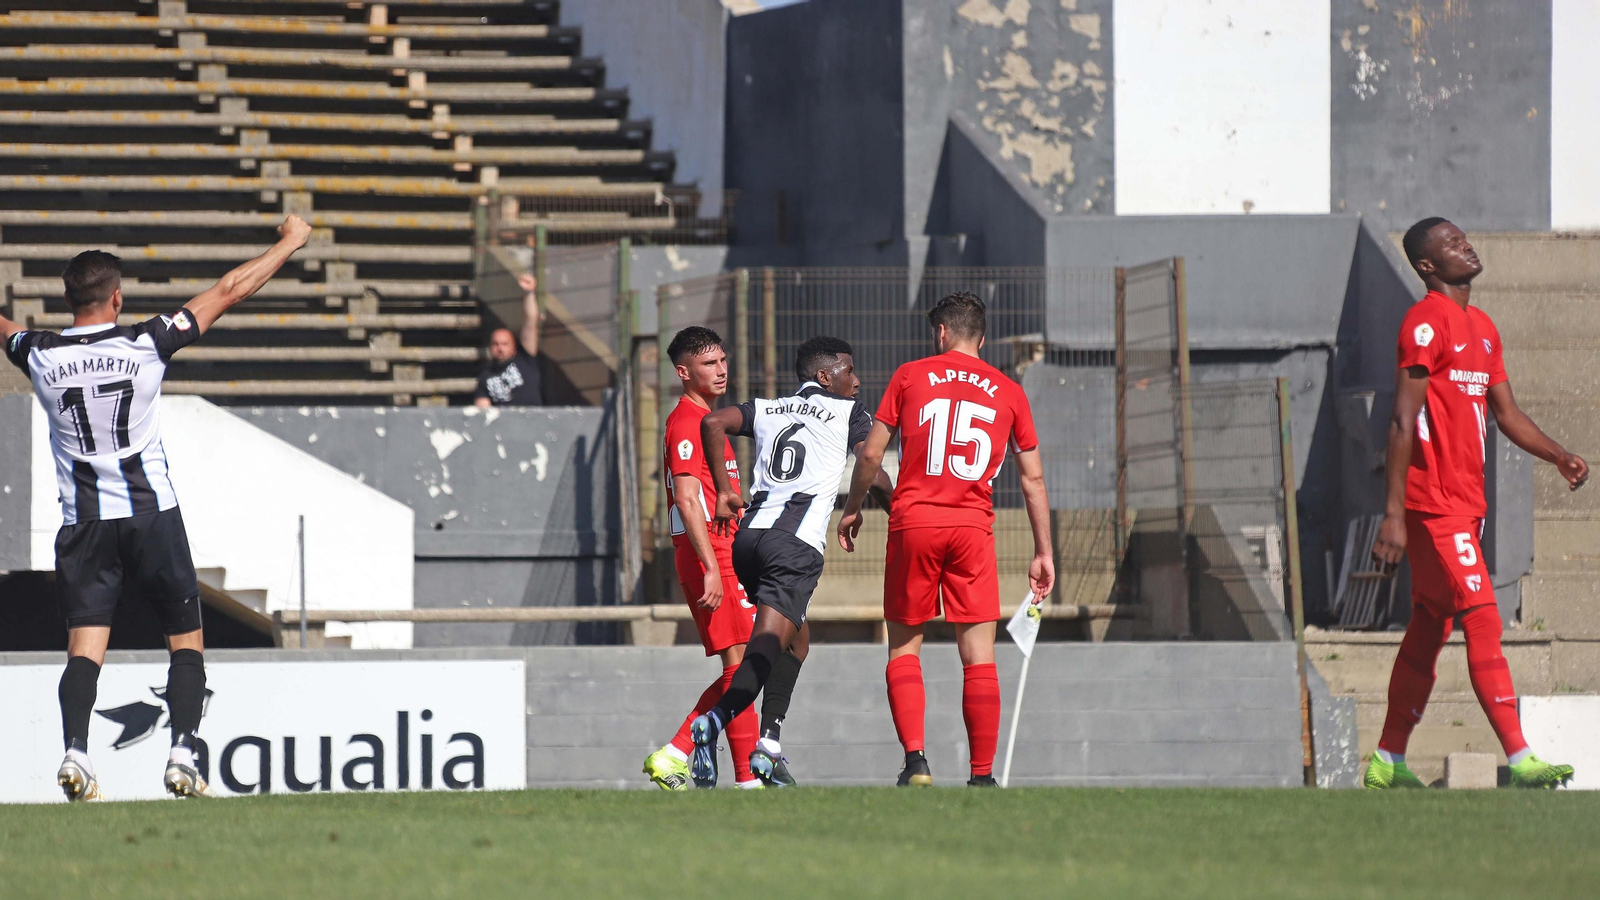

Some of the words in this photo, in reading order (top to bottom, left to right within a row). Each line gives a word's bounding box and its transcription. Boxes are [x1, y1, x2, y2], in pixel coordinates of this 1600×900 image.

[43, 361, 79, 387] IVÁN
[83, 357, 140, 377] MARTÍN
[928, 369, 999, 398] A.PERAL
[57, 379, 134, 456] 17
[766, 403, 836, 423] COULIBALY
[768, 422, 807, 484] 6
[919, 398, 997, 481] 15
[1454, 531, 1478, 567] 5
